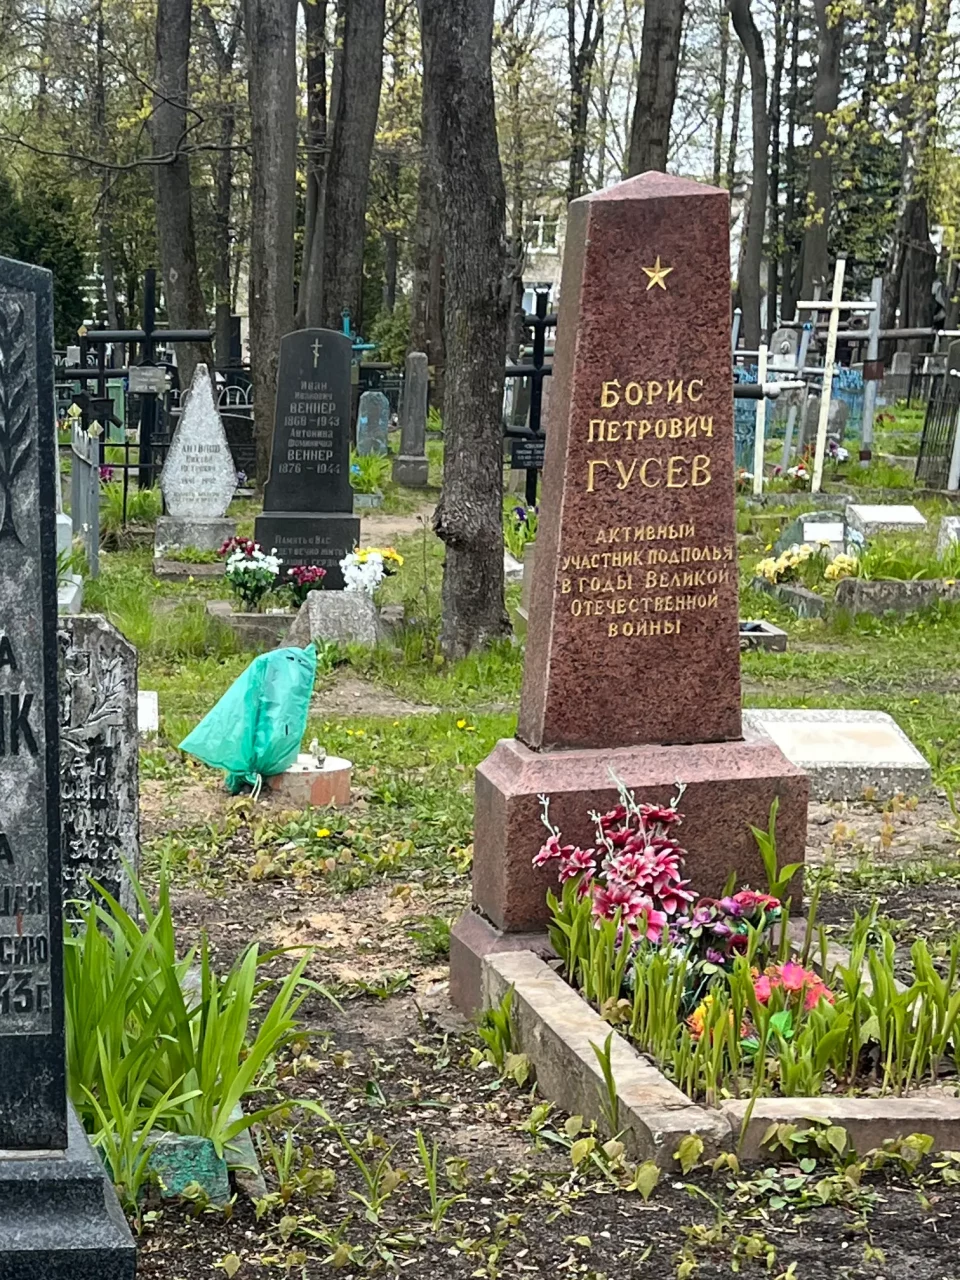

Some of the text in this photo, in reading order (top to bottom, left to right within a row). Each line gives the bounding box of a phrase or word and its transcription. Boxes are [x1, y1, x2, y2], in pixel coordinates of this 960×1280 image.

[600, 378, 704, 408] БОРИС
[290, 402, 336, 414] ВЕННЕР
[587, 416, 714, 443] ПЕТРОВИЧ
[288, 450, 333, 460] ВЕННЕР
[278, 463, 301, 474] 1876
[586, 454, 712, 493] ГУСЕВ
[595, 520, 695, 544] АКТИВНЫЙ
[562, 546, 733, 571] УЧАСТНИК ПОДПОЛЬЯ
[562, 564, 730, 594] В ГОДЫ ВЕЛИКОЙ
[570, 588, 718, 617] ОТЕЧЕСТВЕННОЙ
[608, 618, 681, 638] ВОЙНЫ
